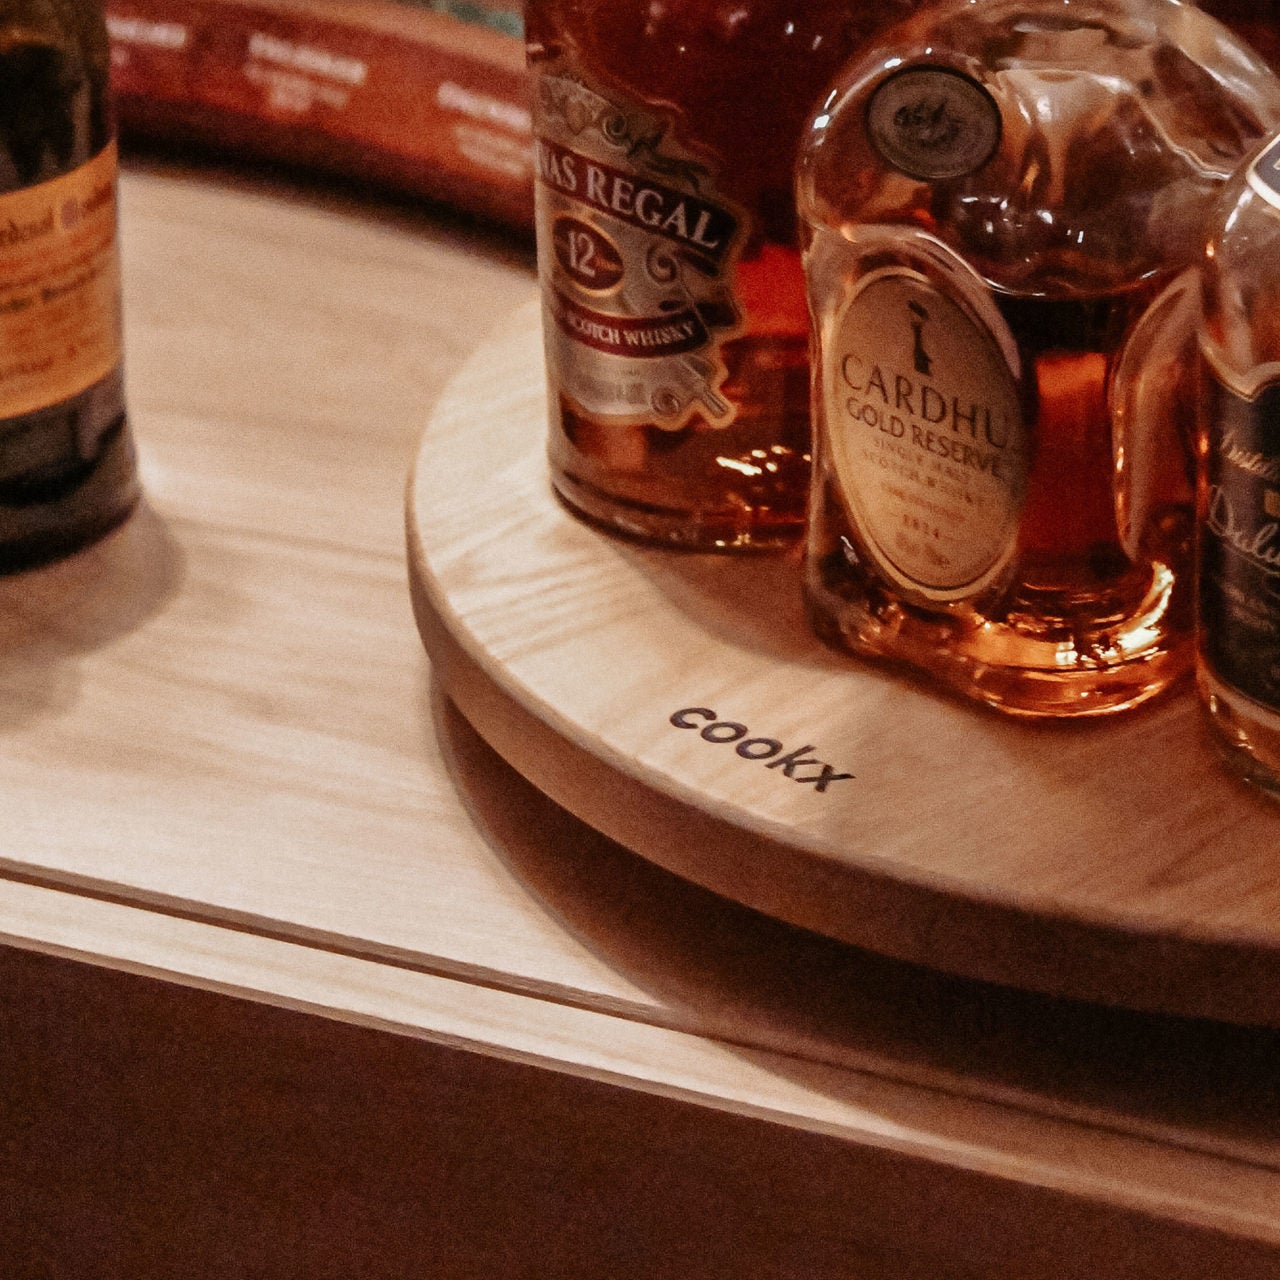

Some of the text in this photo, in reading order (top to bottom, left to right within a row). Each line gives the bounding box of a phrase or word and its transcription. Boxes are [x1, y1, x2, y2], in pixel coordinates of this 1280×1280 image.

[586, 163, 718, 250] REGAL
[567, 230, 596, 278] 12
[841, 353, 1009, 449] CARDHU
[846, 396, 1004, 480] GOLD RESERVE
